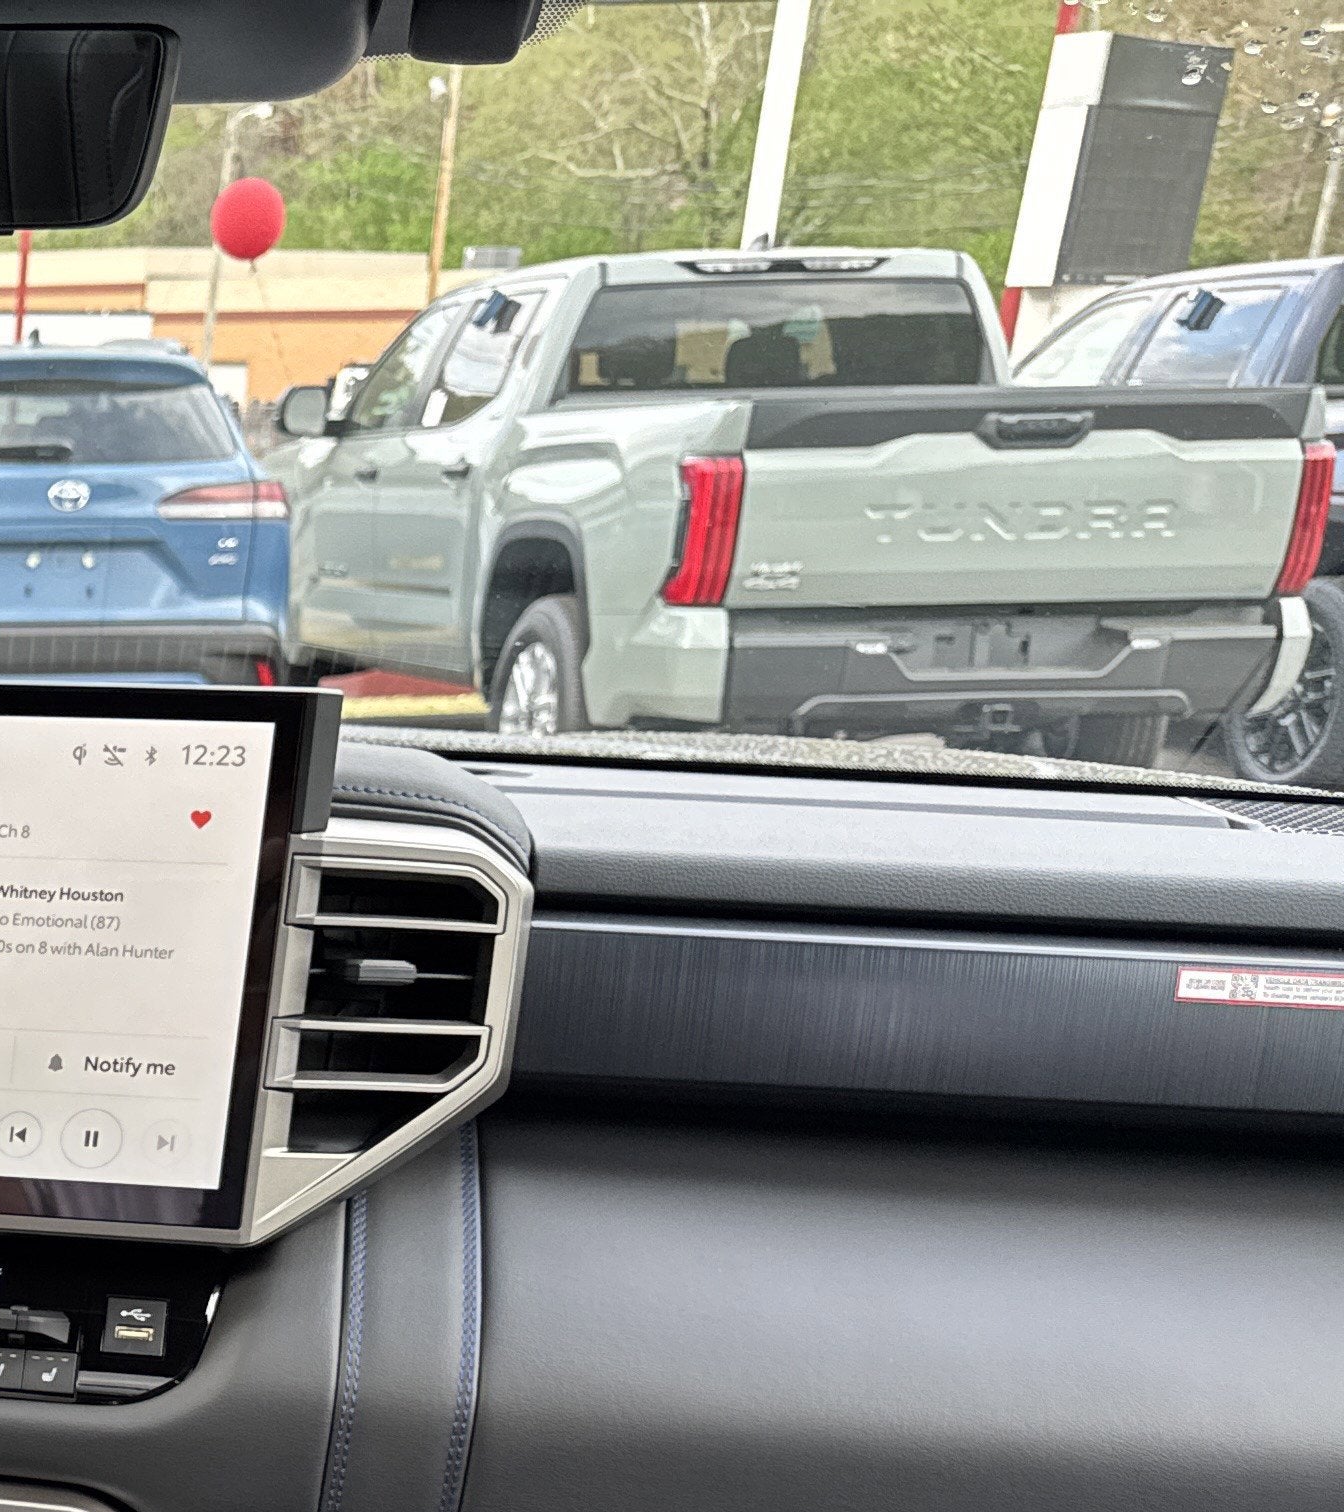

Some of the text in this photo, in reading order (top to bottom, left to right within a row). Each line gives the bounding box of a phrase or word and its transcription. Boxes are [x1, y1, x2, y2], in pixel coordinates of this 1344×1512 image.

[863, 500, 1177, 543] TUNDRA
[181, 744, 247, 767] 12:23
[21, 825, 30, 839] 8
[59, 887, 124, 902] Houston
[12, 913, 88, 930] Emotional
[90, 915, 120, 932] (87)
[16, 943, 36, 954] on
[38, 941, 48, 955] 8
[51, 941, 82, 956] with
[85, 943, 119, 958] Alan
[122, 945, 174, 960] Hunter
[85, 1056, 175, 1077] Notify me
